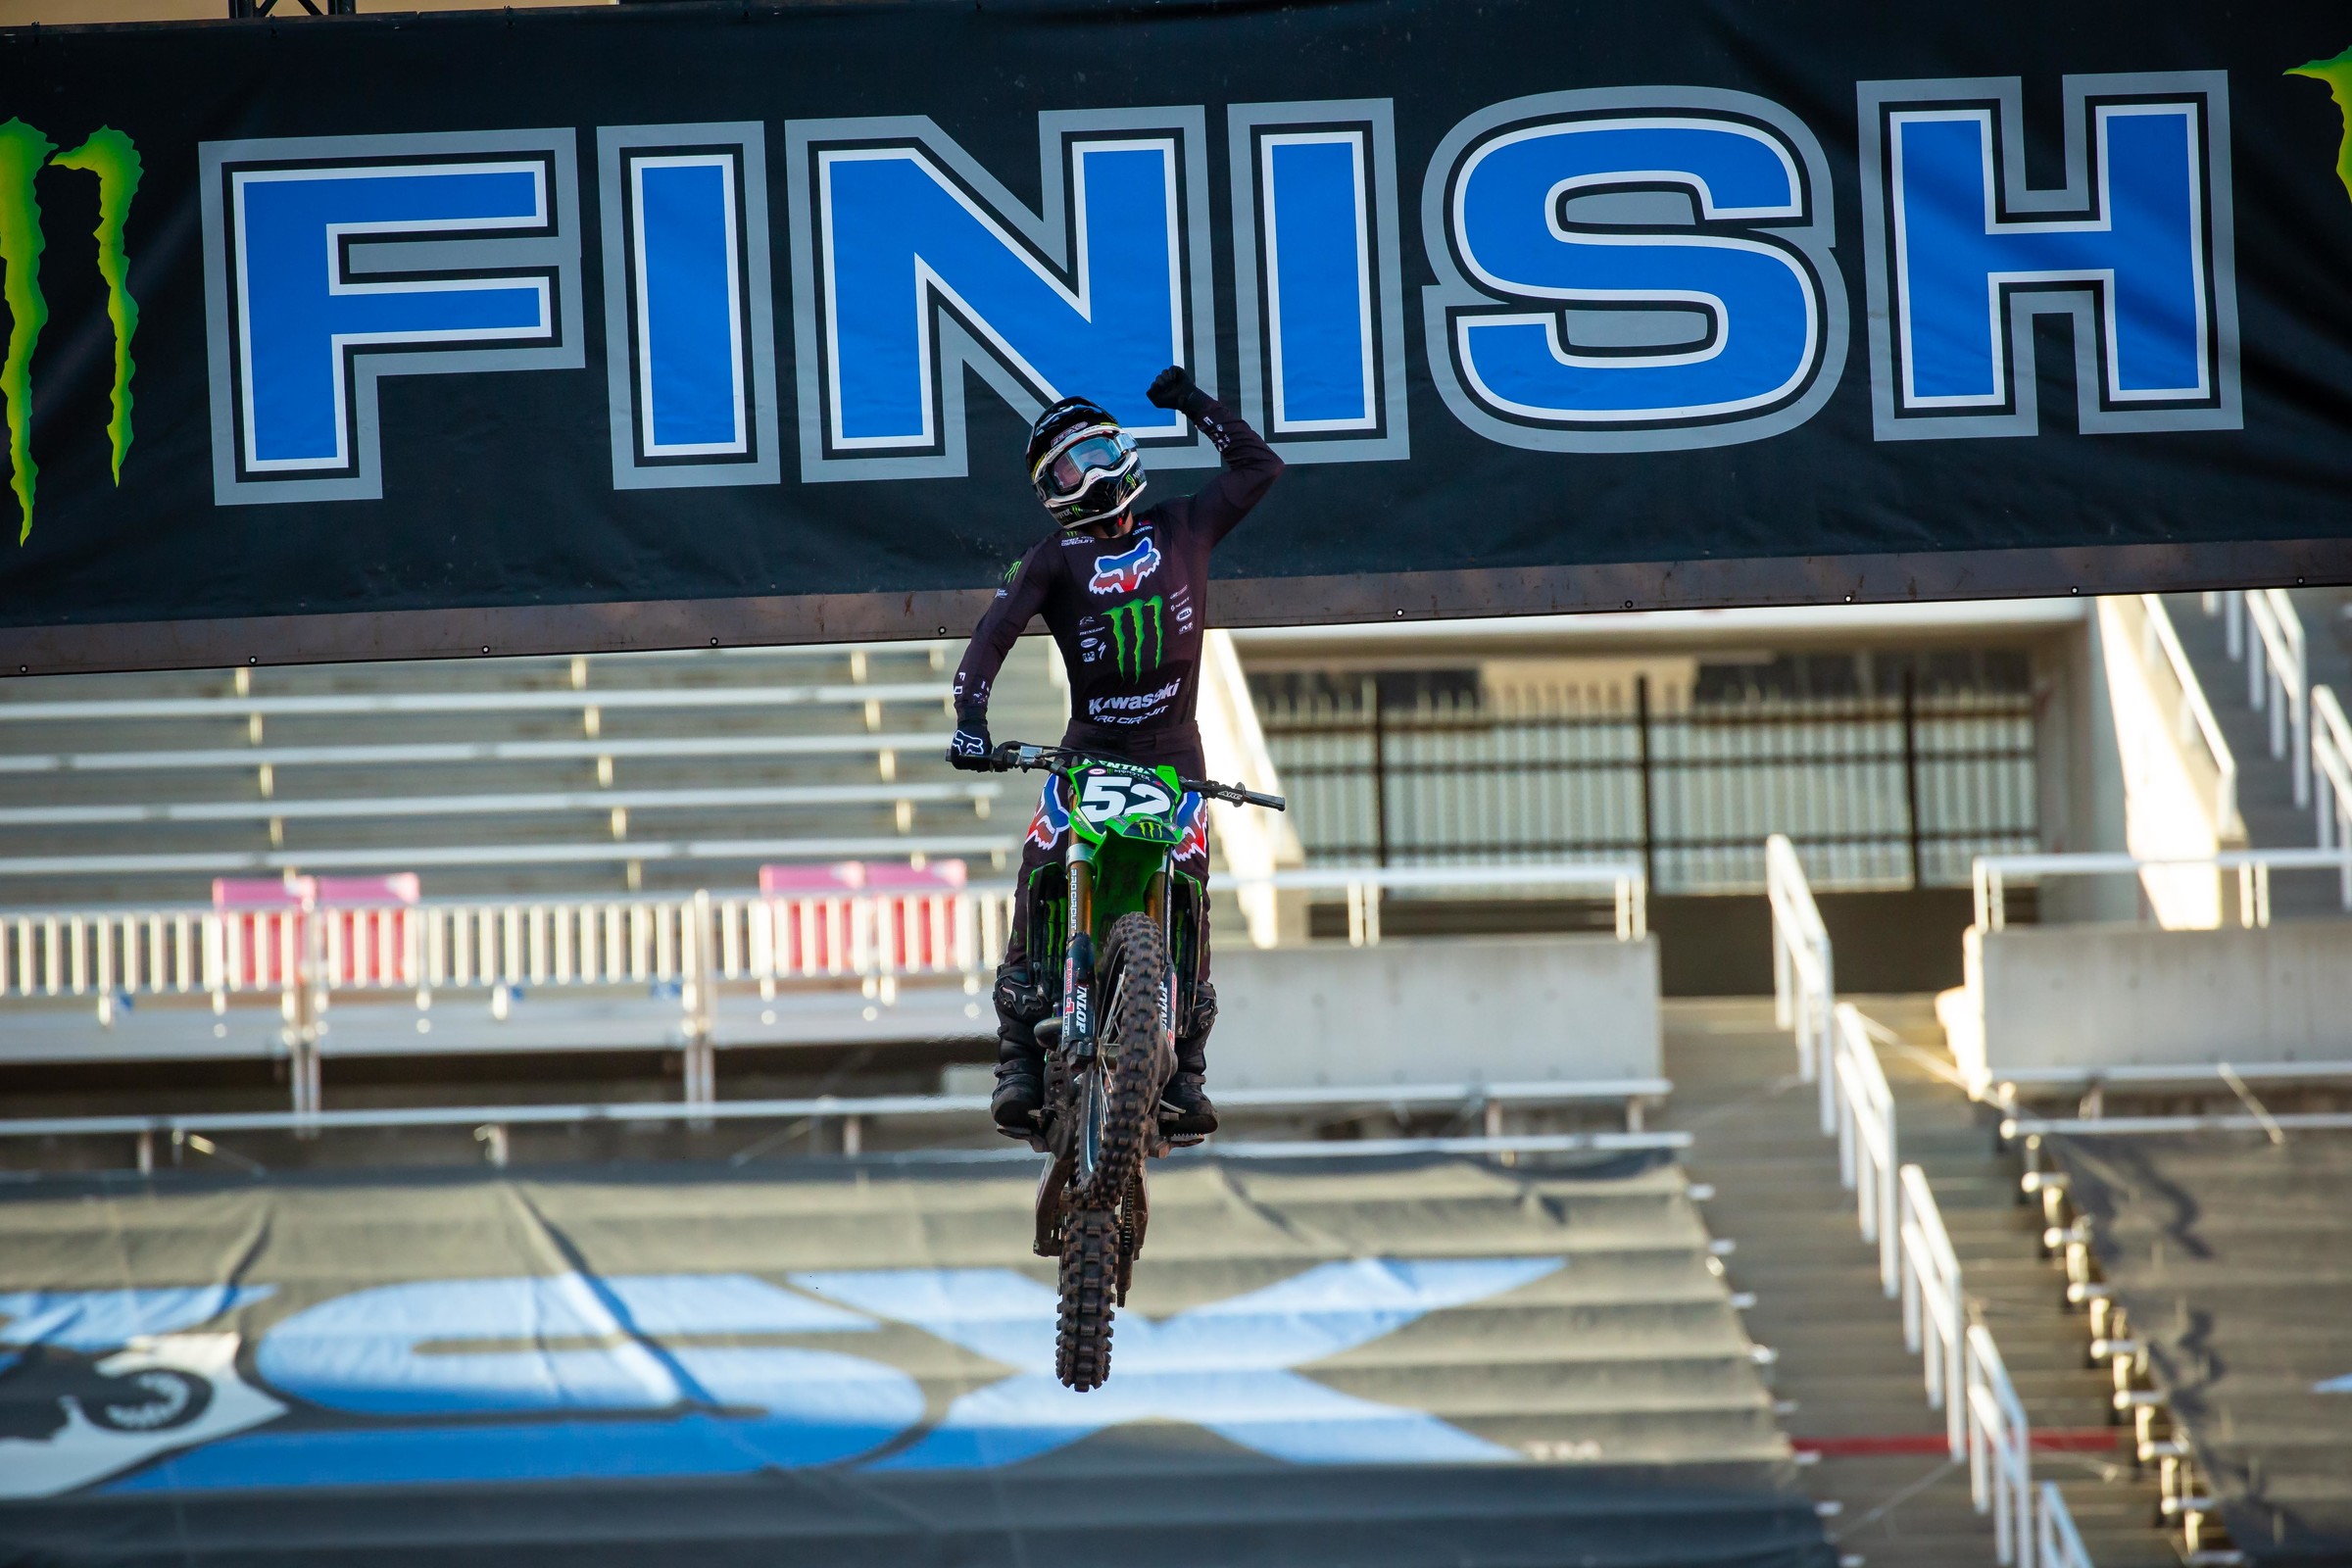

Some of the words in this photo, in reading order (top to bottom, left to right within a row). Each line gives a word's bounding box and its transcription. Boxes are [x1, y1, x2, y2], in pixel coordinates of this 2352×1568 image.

[199, 71, 2243, 507] FINISH
[1080, 776, 1171, 822] 52
[1076, 985, 1088, 1034] NLOP
